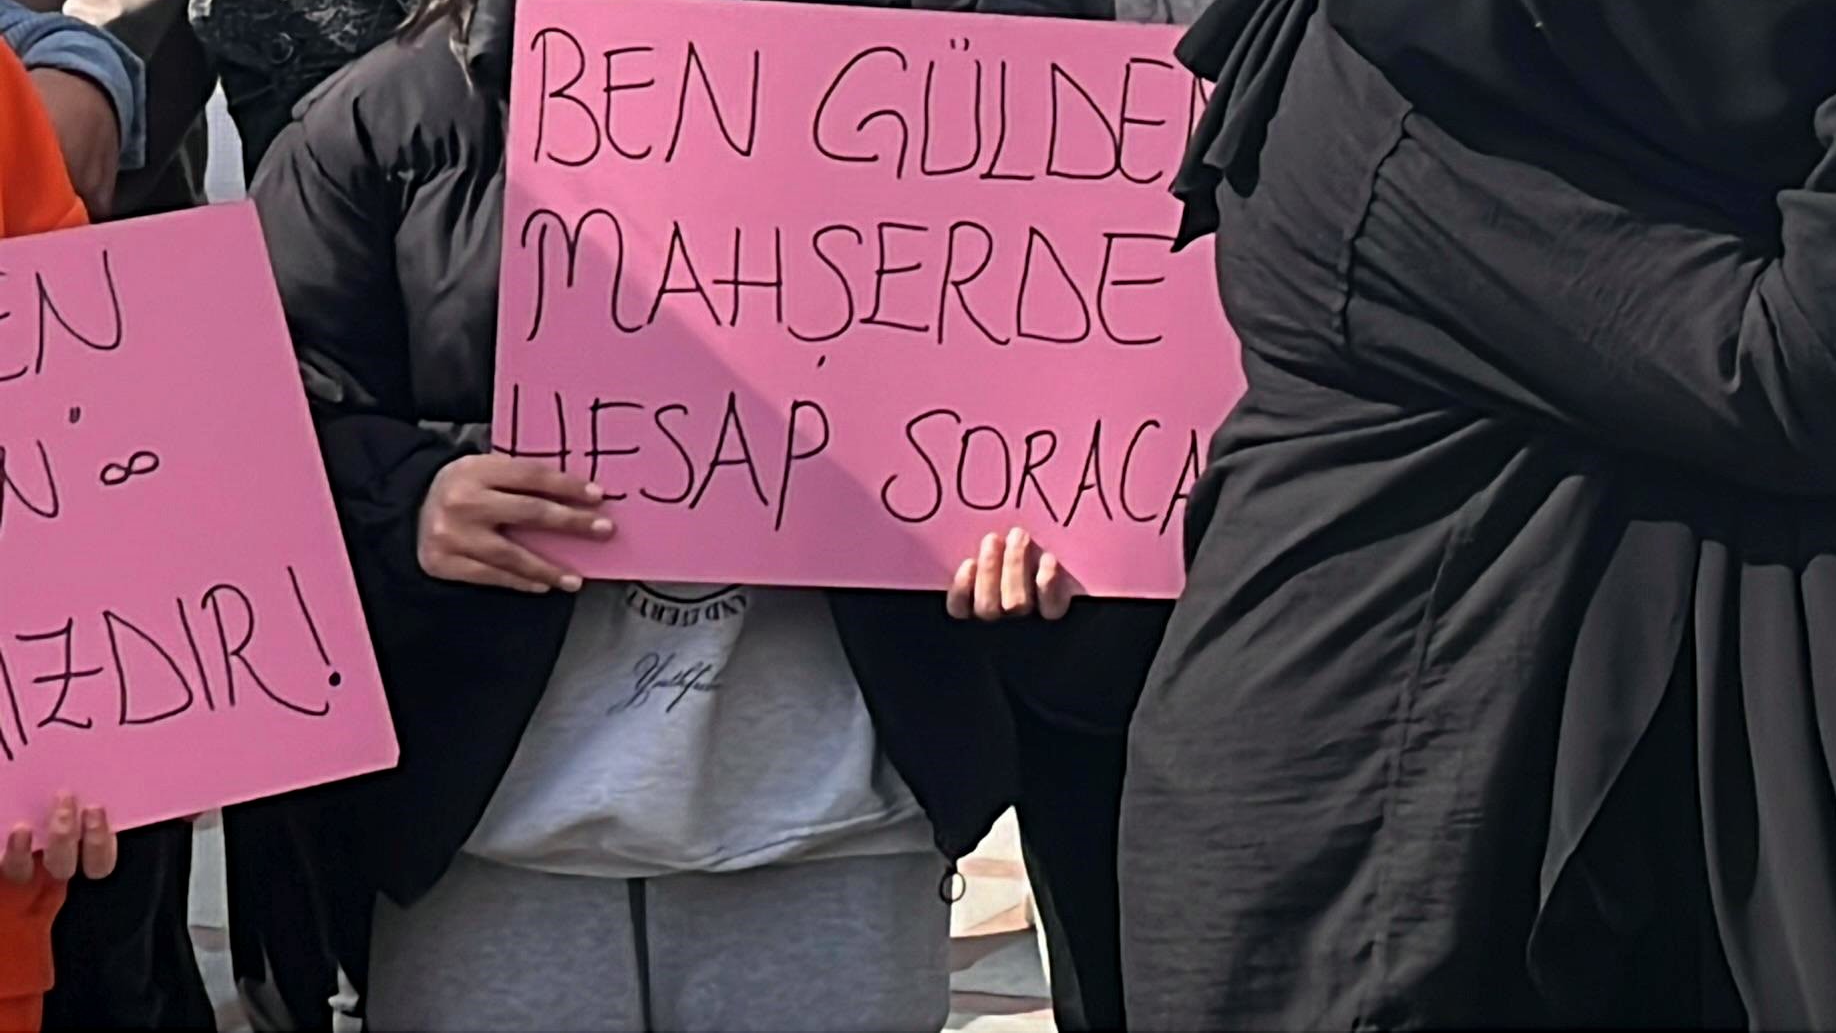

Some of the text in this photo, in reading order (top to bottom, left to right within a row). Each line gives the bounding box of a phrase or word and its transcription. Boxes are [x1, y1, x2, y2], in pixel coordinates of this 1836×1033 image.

[531, 27, 760, 167] BEN
[520, 207, 1177, 368] MAHŞERDE
[500, 382, 830, 531] HESAP
[880, 408, 1199, 534] SORACA
